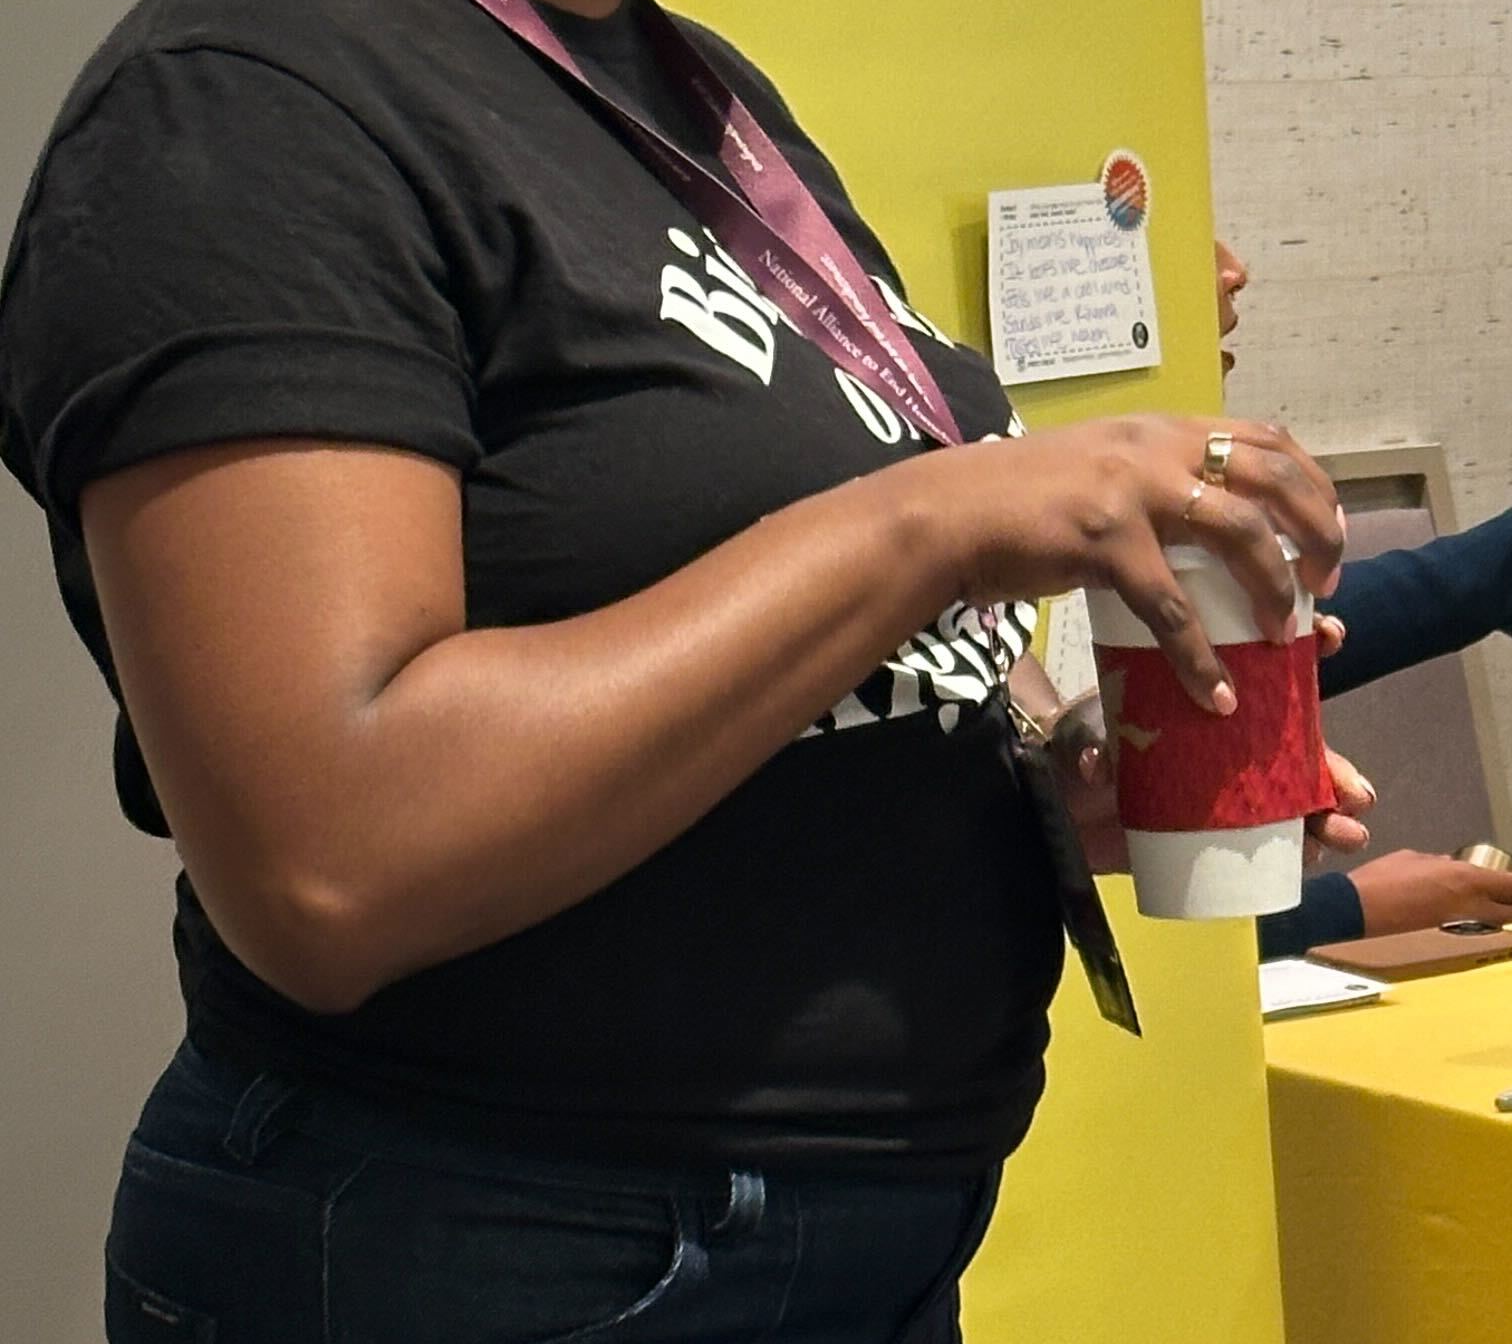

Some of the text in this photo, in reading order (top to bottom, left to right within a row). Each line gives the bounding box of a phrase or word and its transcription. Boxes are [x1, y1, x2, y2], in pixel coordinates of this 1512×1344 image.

[760, 251, 817, 308] National
[813, 307, 862, 359] Alliance
[862, 356, 878, 370] to
